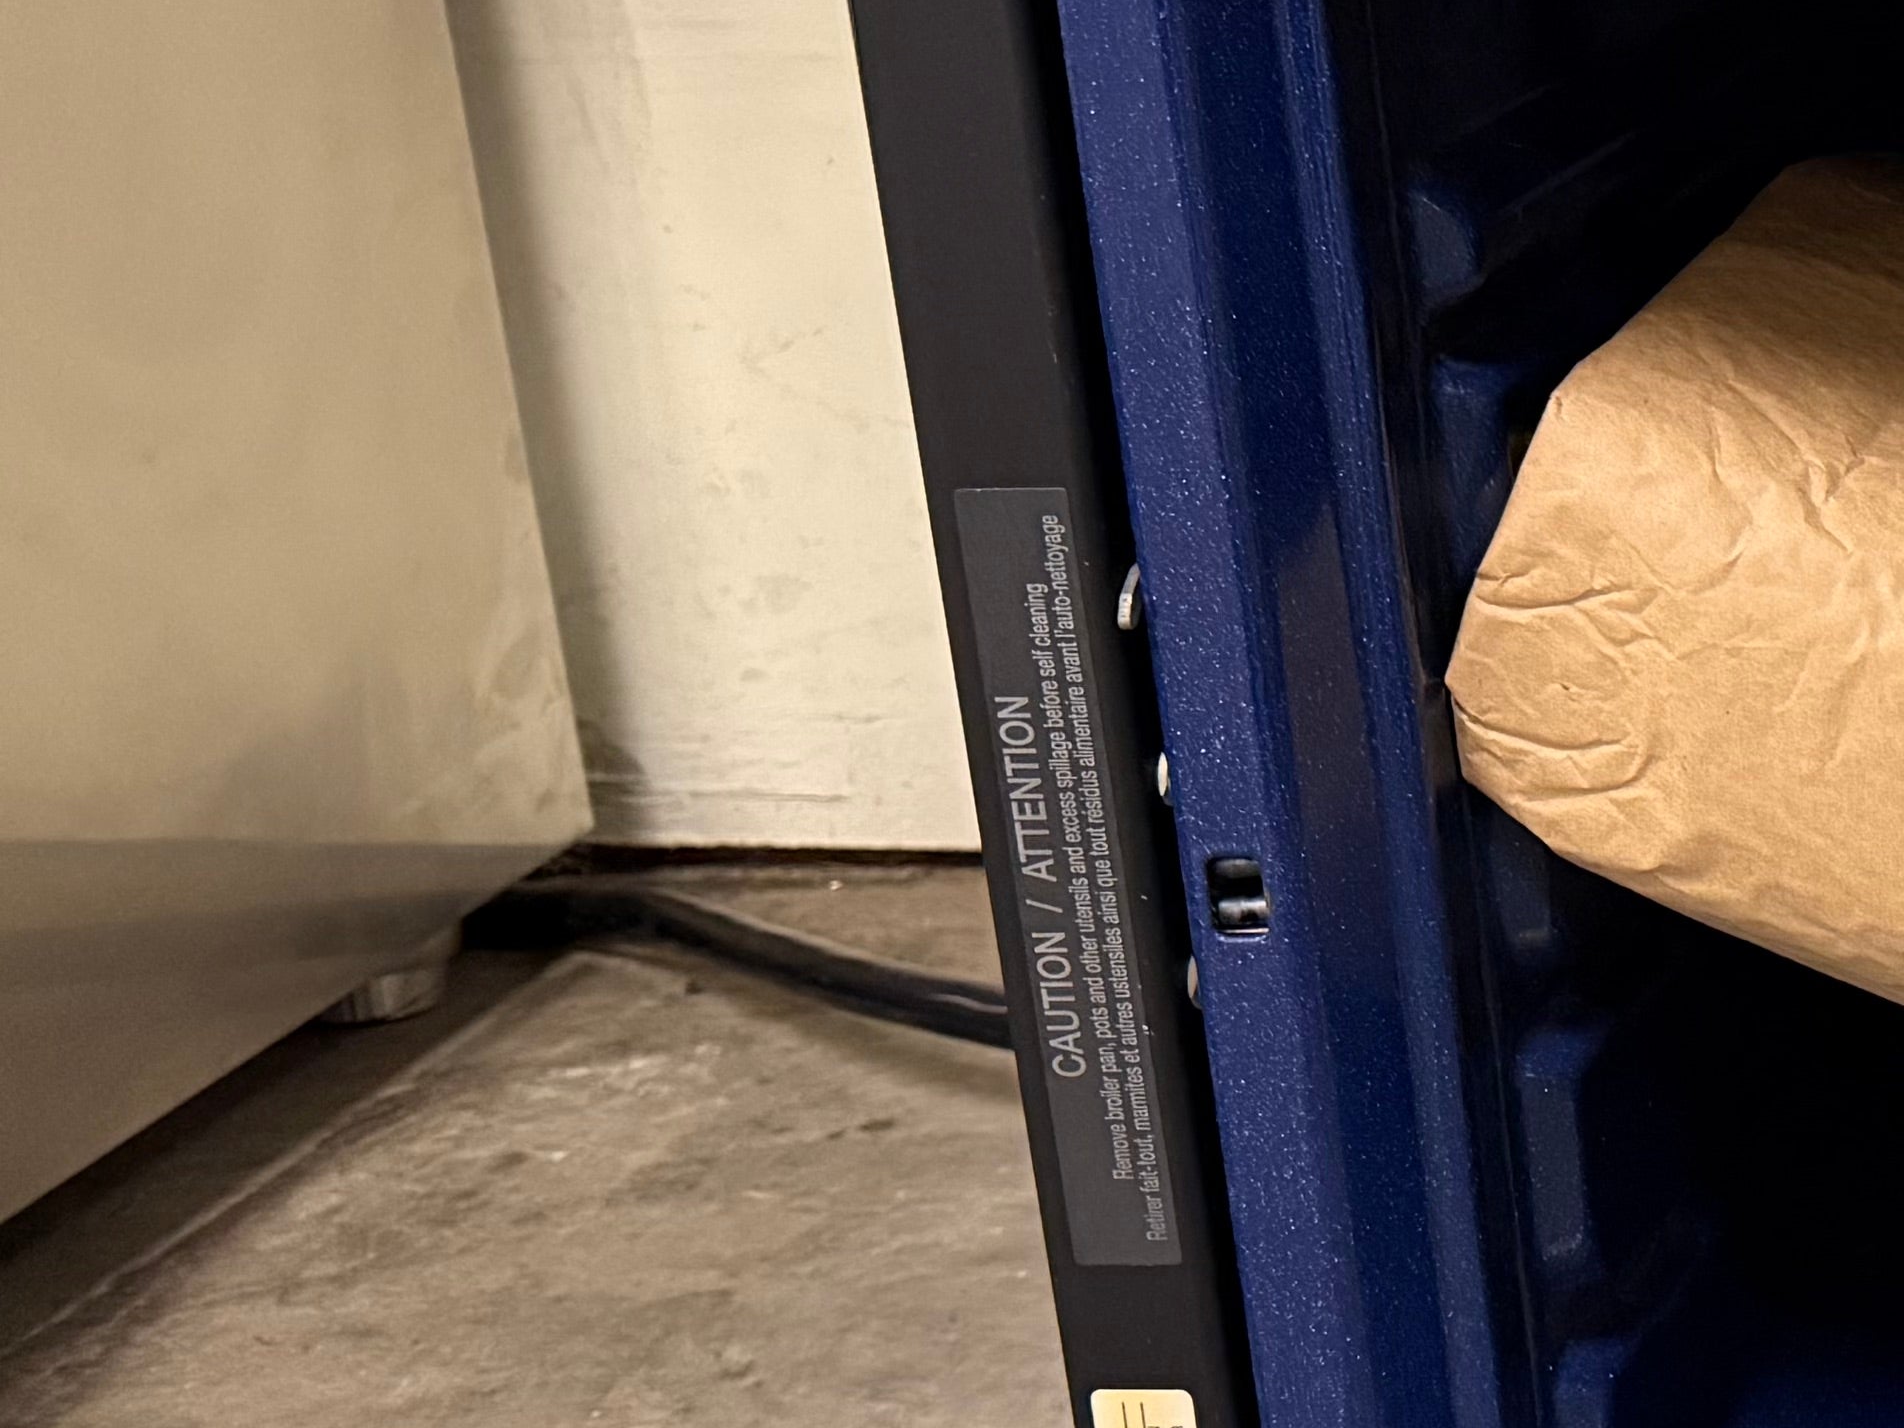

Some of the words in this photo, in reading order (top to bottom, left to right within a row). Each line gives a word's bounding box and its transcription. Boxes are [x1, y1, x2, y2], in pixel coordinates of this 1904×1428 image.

[1024, 584, 1051, 646] cleaning
[1031, 651, 1056, 676] self
[1058, 642, 1083, 682] avant
[1040, 681, 1064, 728] before
[1065, 687, 1095, 767] alimentaire
[1048, 732, 1077, 788] spillage
[994, 697, 1057, 882] ATTENTION
[1079, 771, 1104, 823] résidus
[1059, 792, 1081, 842] excess
[1062, 847, 1086, 873] and
[1086, 828, 1109, 856] tout
[1095, 860, 1117, 887] que
[1068, 877, 1095, 932] utensils
[1095, 892, 1119, 924] ainsi
[1079, 935, 1102, 973] other
[1102, 928, 1130, 998] ustensiles
[1031, 933, 1086, 1077] CAUTION
[1082, 978, 1106, 1003] and
[1091, 1007, 1116, 1038] pots
[1116, 1002, 1137, 1045] autres
[1098, 1044, 1121, 1072] pan,
[1120, 1049, 1140, 1063] et
[1100, 1078, 1124, 1120] broiler
[1121, 1067, 1151, 1130] marmites
[1110, 1124, 1134, 1179] Remove
[1133, 1134, 1160, 1192] fait-tout,
[1144, 1196, 1168, 1240] Retirer
